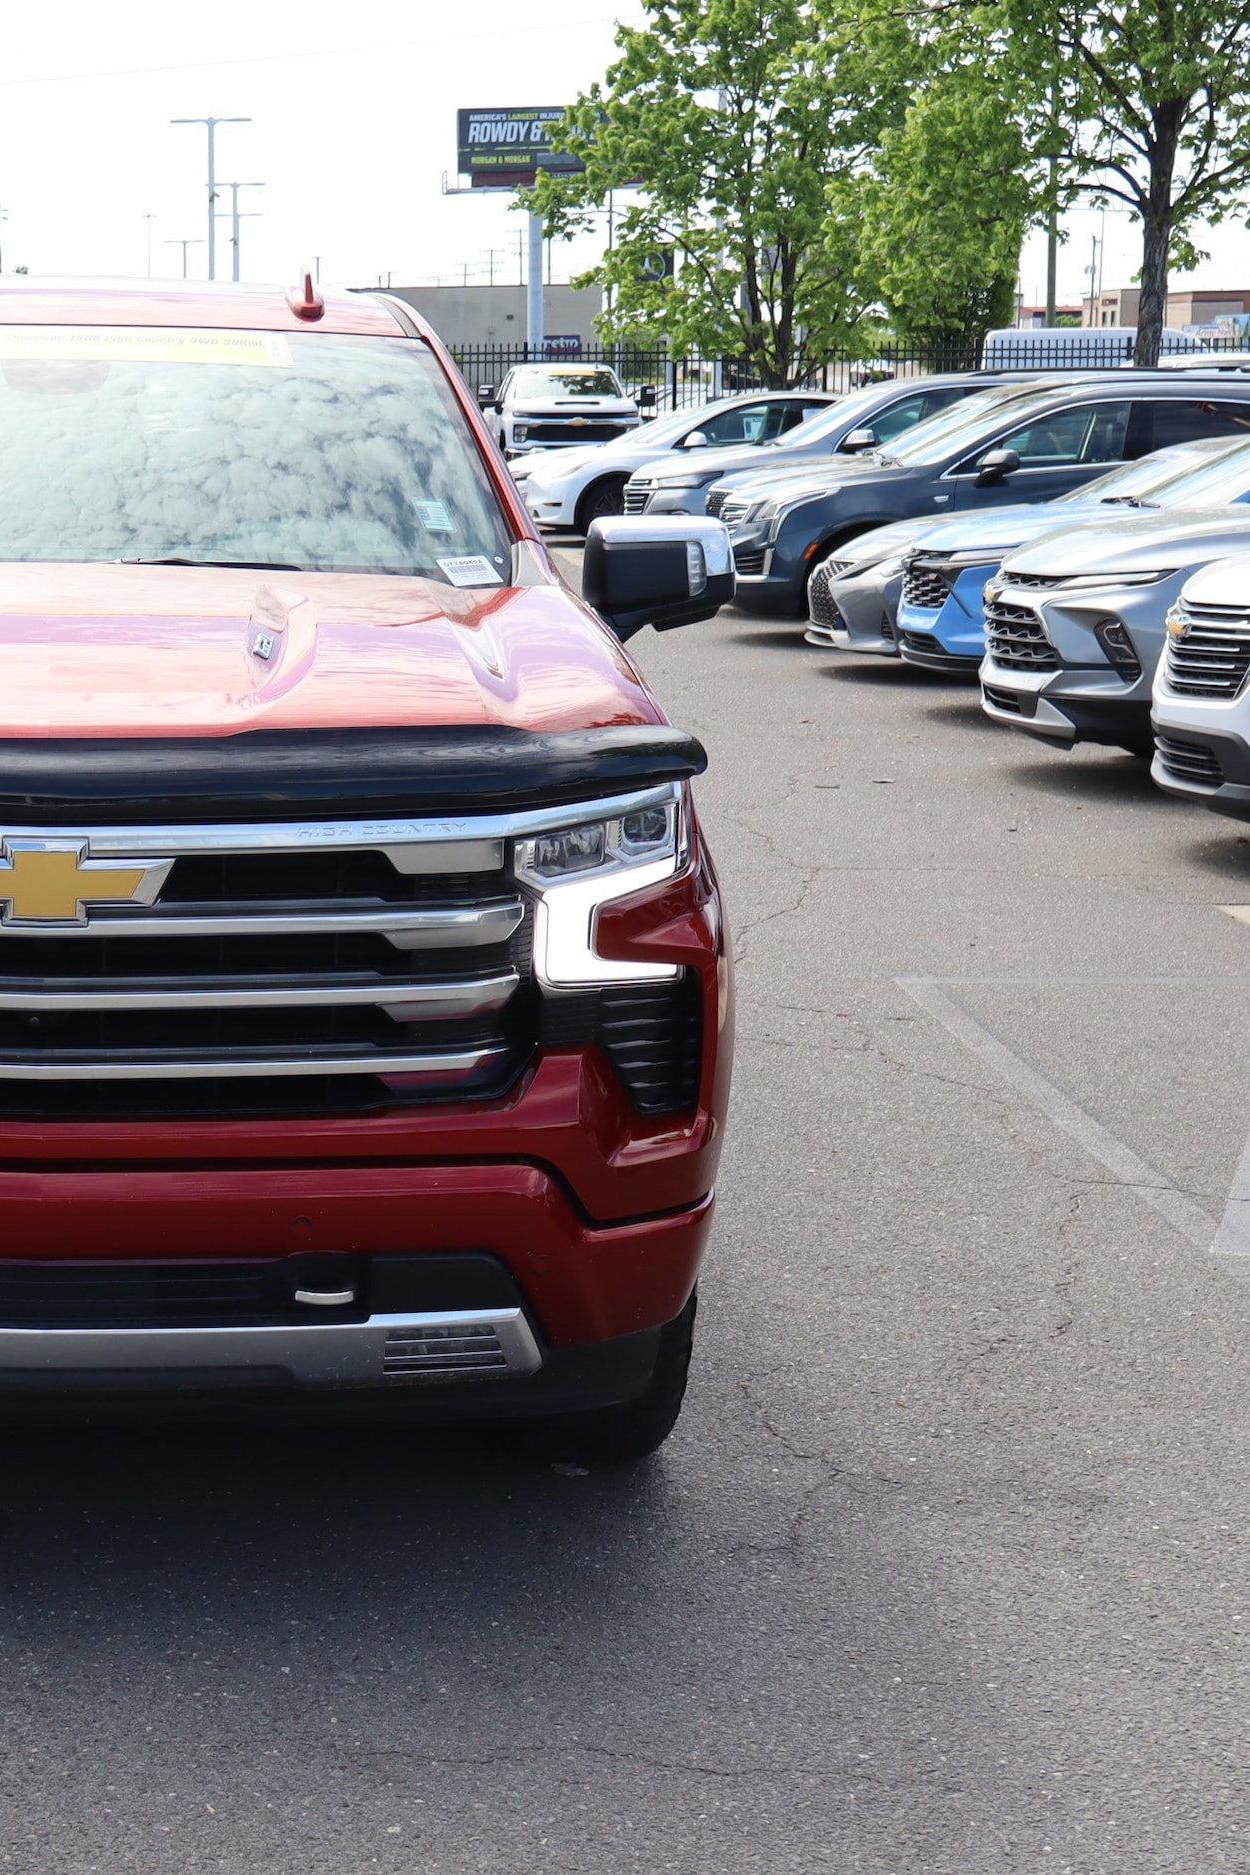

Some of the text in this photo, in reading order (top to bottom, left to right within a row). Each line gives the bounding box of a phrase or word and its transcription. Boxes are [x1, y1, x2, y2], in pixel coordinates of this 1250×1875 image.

[469, 113, 506, 121] AMERICA'S
[508, 112, 538, 120] LARGEST
[468, 121, 530, 144] ROWDY
[136, 335, 186, 346] Country
[298, 822, 467, 838] HIGH COUNTRY
